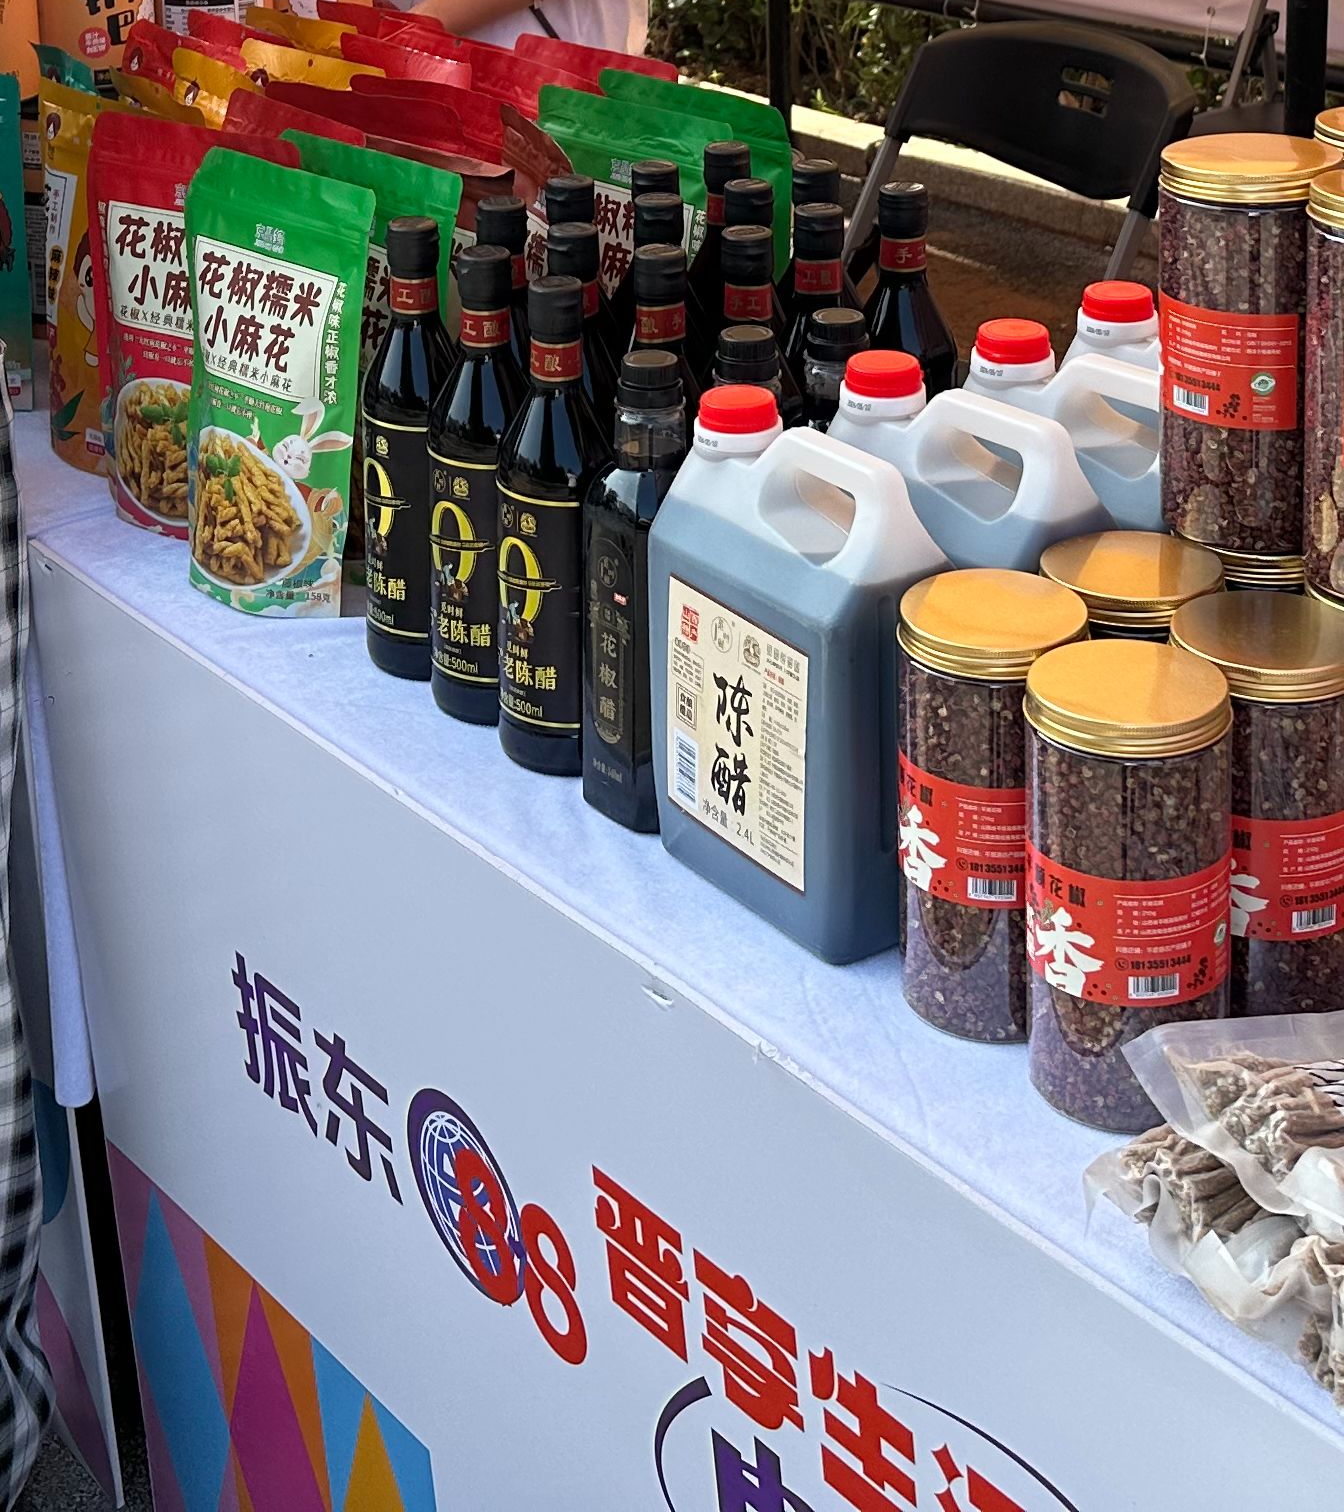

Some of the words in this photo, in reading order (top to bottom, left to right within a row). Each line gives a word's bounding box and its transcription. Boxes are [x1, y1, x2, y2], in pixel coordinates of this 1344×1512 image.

[198, 250, 323, 328] 花椒糯米
[203, 304, 296, 374] 小麻花
[436, 615, 492, 648] 老陈醋
[502, 658, 558, 692] 老陈醋
[598, 630, 618, 722] 花椒醋
[735, 821, 756, 847] 2.4L
[233, 949, 404, 1207] 振东
